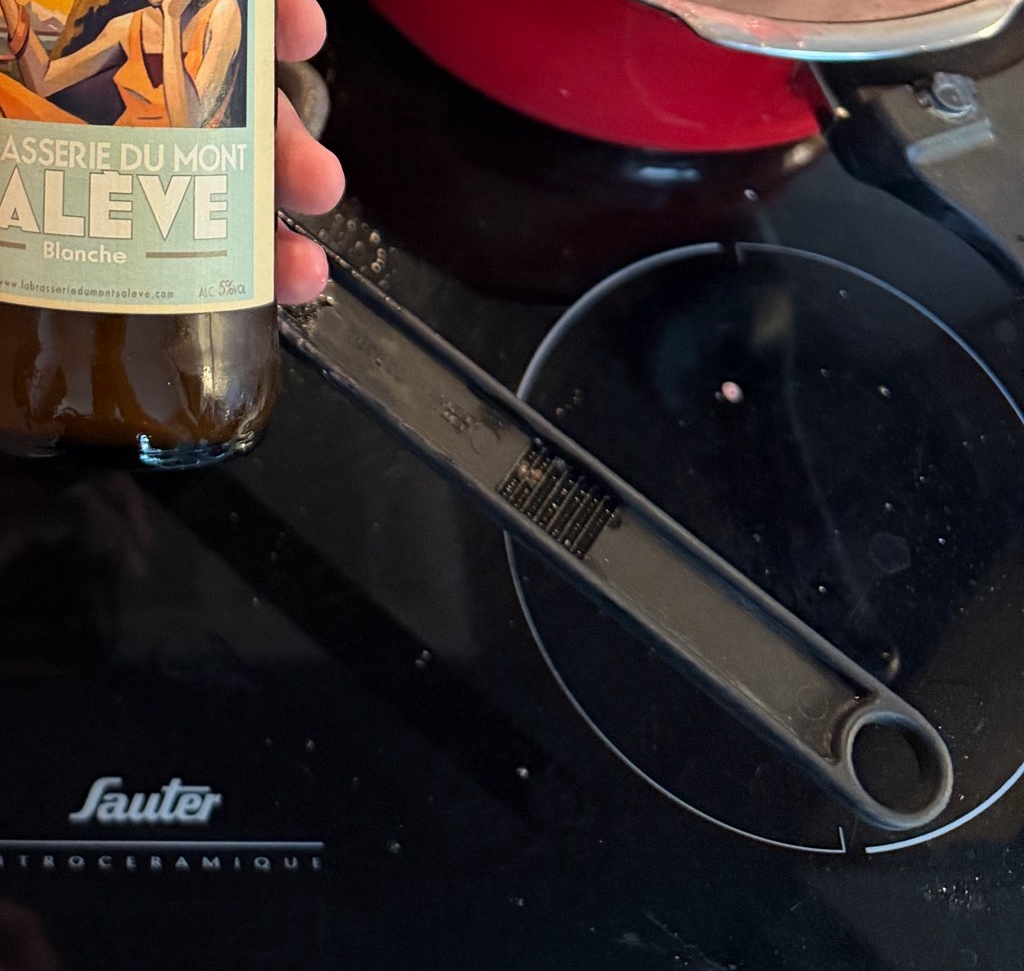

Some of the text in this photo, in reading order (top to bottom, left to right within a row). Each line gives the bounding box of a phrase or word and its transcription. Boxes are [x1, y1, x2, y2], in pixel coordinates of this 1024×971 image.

[120, 143, 165, 172] DU
[174, 143, 247, 172] MONT
[42, 240, 127, 264] Blanche
[69, 776, 222, 825] Sauter
